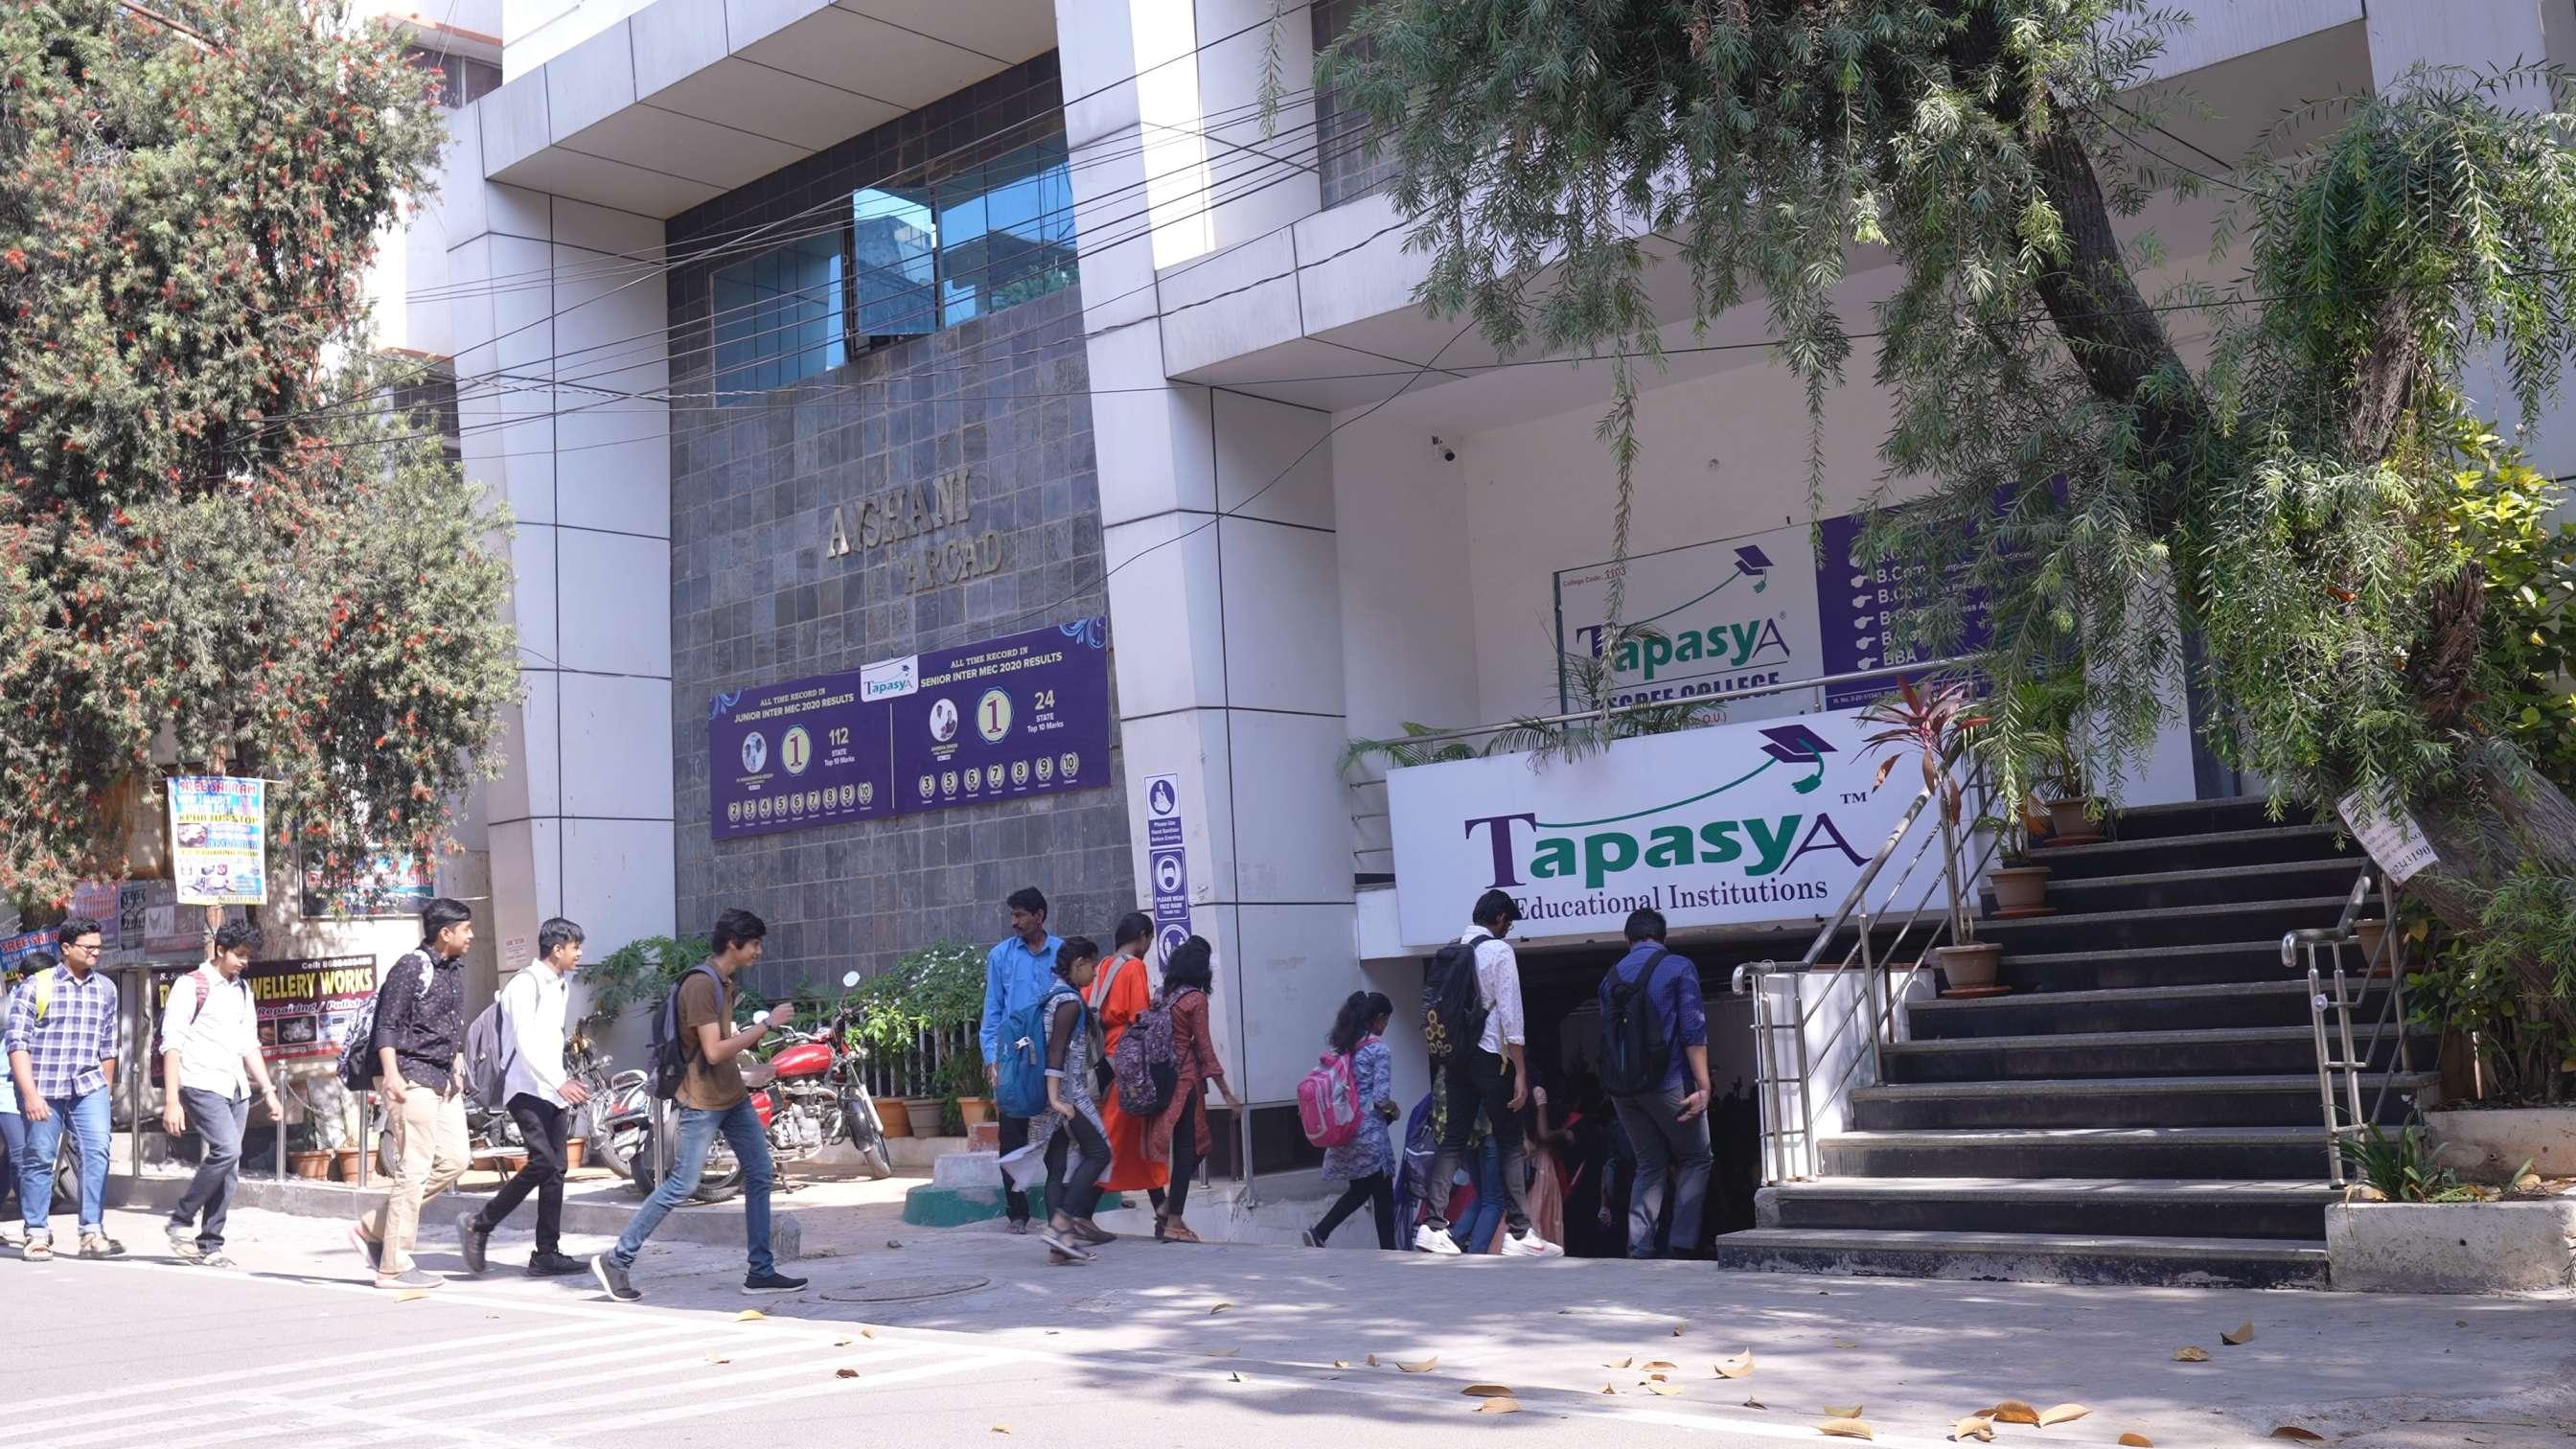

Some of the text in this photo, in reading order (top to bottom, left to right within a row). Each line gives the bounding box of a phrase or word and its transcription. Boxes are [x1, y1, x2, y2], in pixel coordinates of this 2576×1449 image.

[951, 646, 1028, 668] ALL TIME RECORD IN
[920, 652, 1062, 687] SENIOR INTER MEC 2020 RESULTS
[734, 693, 854, 723] JUNIOR INTER MEC 2020 RESULTS
[760, 698, 772, 706] ALL
[773, 694, 790, 703] TIME
[791, 689, 816, 701] RECORD
[1034, 689, 1055, 710] 24
[987, 699, 1001, 733] 1
[1036, 712, 1054, 723] STATE
[829, 726, 849, 746] 112
[1027, 724, 1038, 734] Top
[1046, 721, 1064, 730] Marks
[789, 735, 802, 767] 1
[832, 748, 847, 757] STATE
[924, 756, 1074, 790] 3 5 6 7 8 9 10
[1840, 792, 1868, 804] TM
[1513, 879, 1828, 921] Educational Institutions
[250, 968, 373, 1000] WELLERY WORKS
[257, 1002, 316, 1017] Repairing
[326, 998, 364, 1011] Polish
